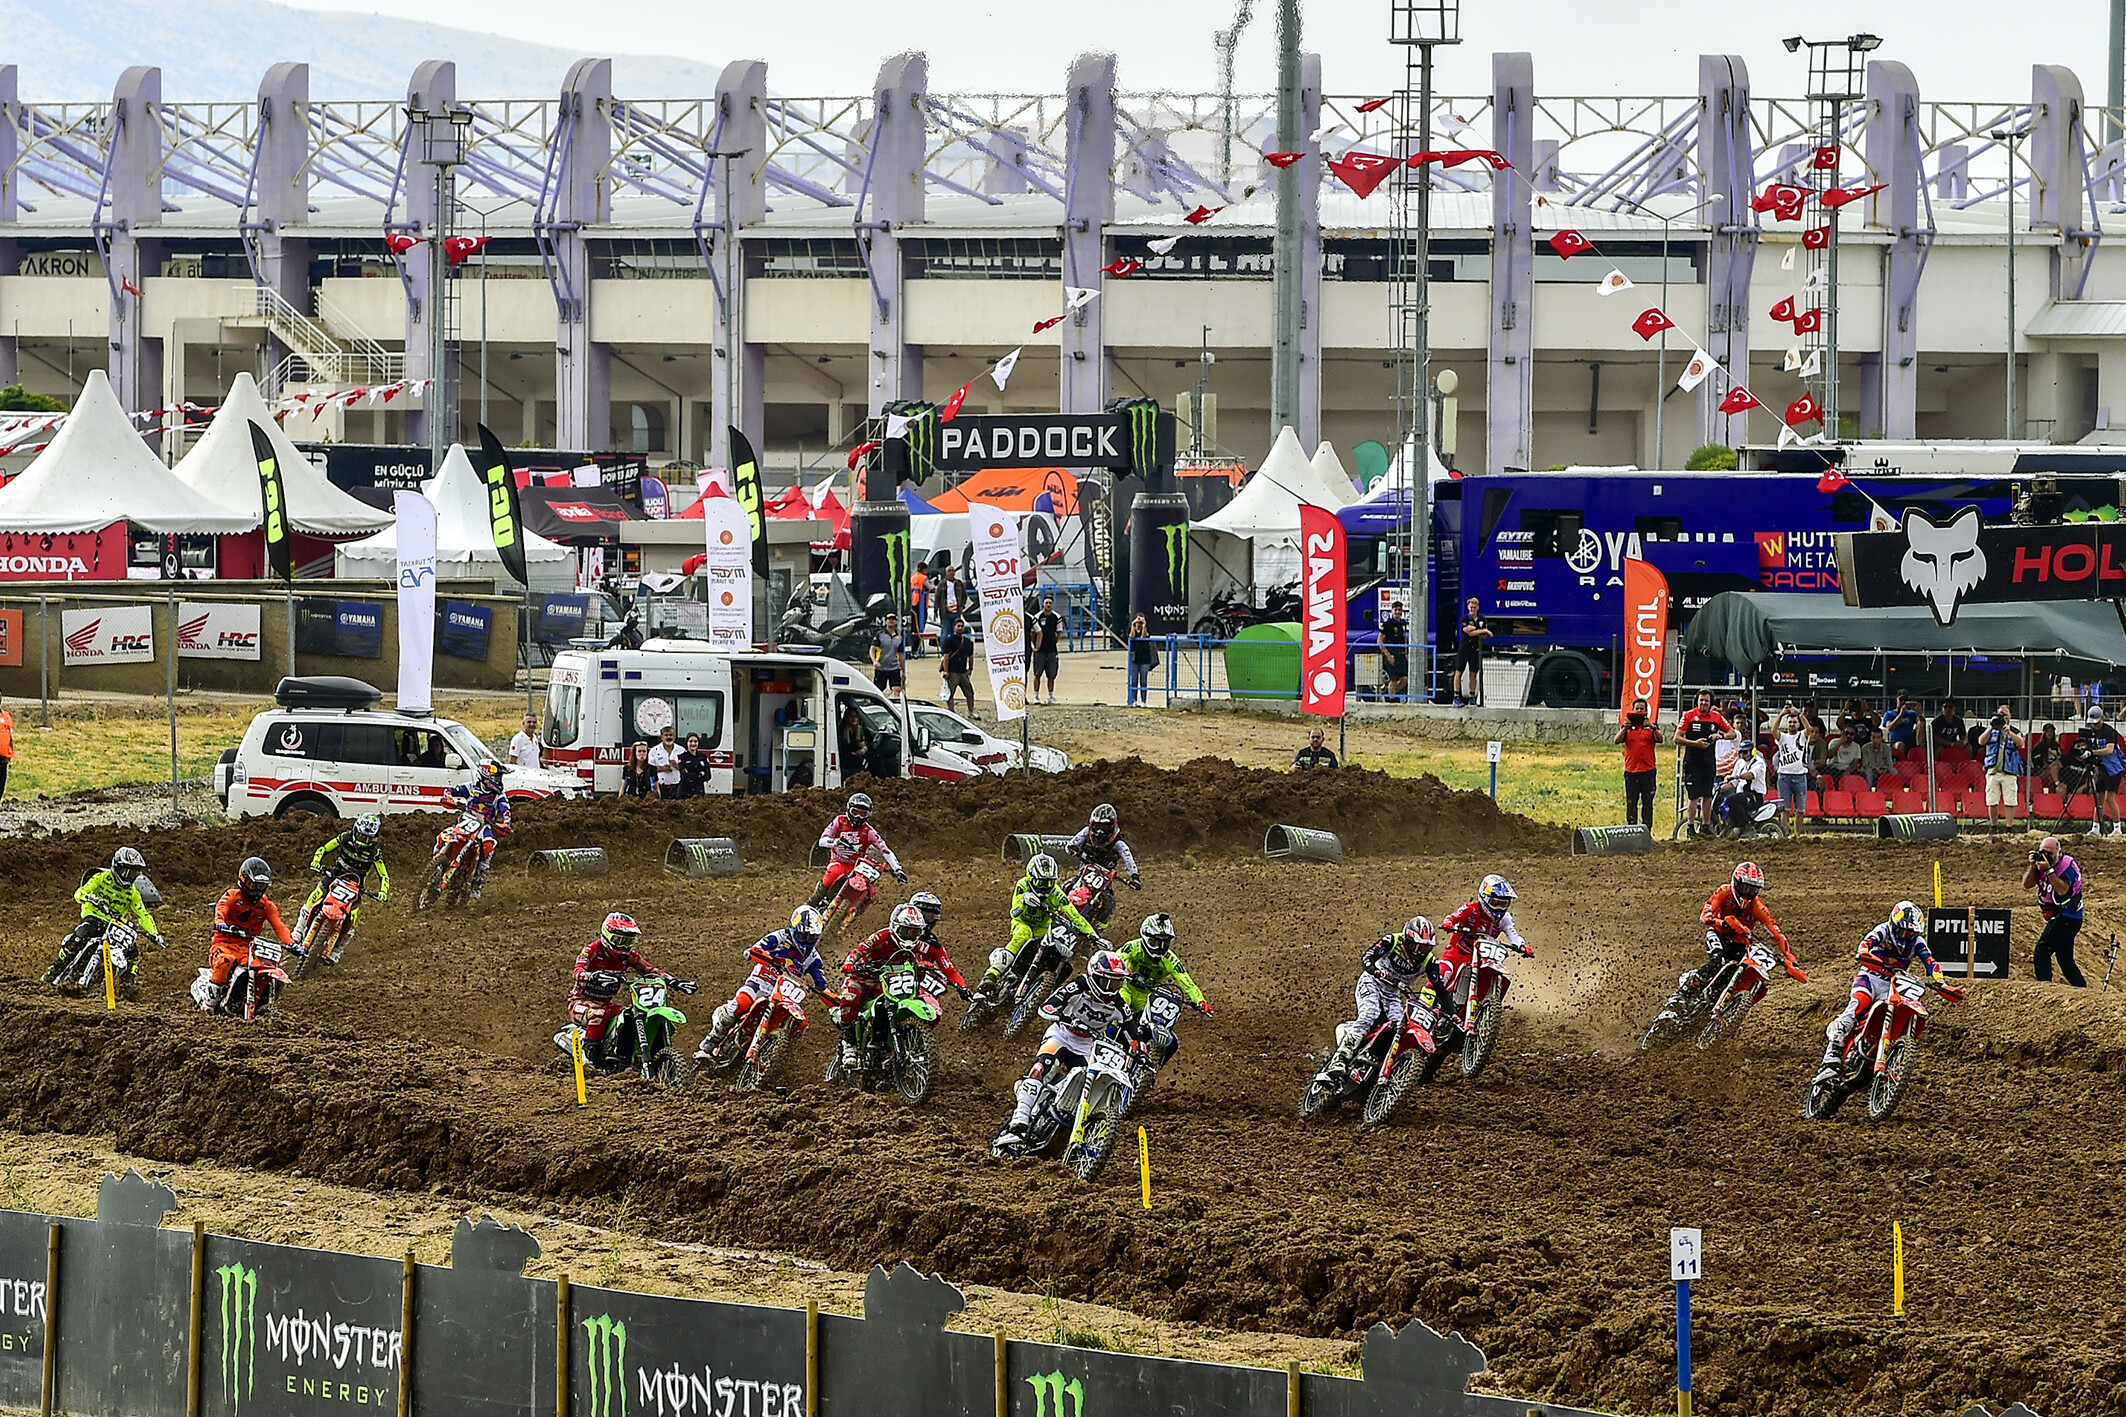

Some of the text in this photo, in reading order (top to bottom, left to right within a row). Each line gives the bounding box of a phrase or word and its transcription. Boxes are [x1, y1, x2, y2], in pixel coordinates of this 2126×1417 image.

[25, 257, 89, 276] AKRON
[941, 425, 1119, 459] PADDOCK
[374, 463, 424, 479] EN GÜÇLÜ
[1497, 532, 1535, 541] GYTR
[1498, 549, 1534, 561] YAMALUBE
[2012, 543, 2126, 583] HOL
[555, 605, 582, 615] YAMAHA
[348, 614, 376, 625] YAMAHA
[456, 613, 484, 628] YAMAHA
[111, 634, 151, 651] HRC
[217, 632, 258, 648] HRC
[66, 649, 105, 658] HONDA
[353, 781, 421, 797] AMBULANS
[458, 815, 481, 833] 79
[1083, 872, 1105, 889] 40
[1934, 918, 2005, 935] PITLANE
[254, 945, 282, 963] 253
[1479, 943, 1507, 961] 516
[780, 980, 807, 1004] 80
[889, 976, 913, 996] 22
[919, 975, 946, 997] 517
[1895, 979, 1925, 1001] 72
[638, 987, 665, 1007] 24
[1077, 1002, 1112, 1024] FOX
[1151, 997, 1181, 1020] 93
[1409, 1007, 1435, 1030] 125
[1097, 1047, 1124, 1068] 39
[1677, 1258, 1697, 1275] 11
[264, 1308, 402, 1371] MONSTER
[286, 1374, 386, 1407] ENERGY
[637, 1361, 803, 1417] MONSTER
